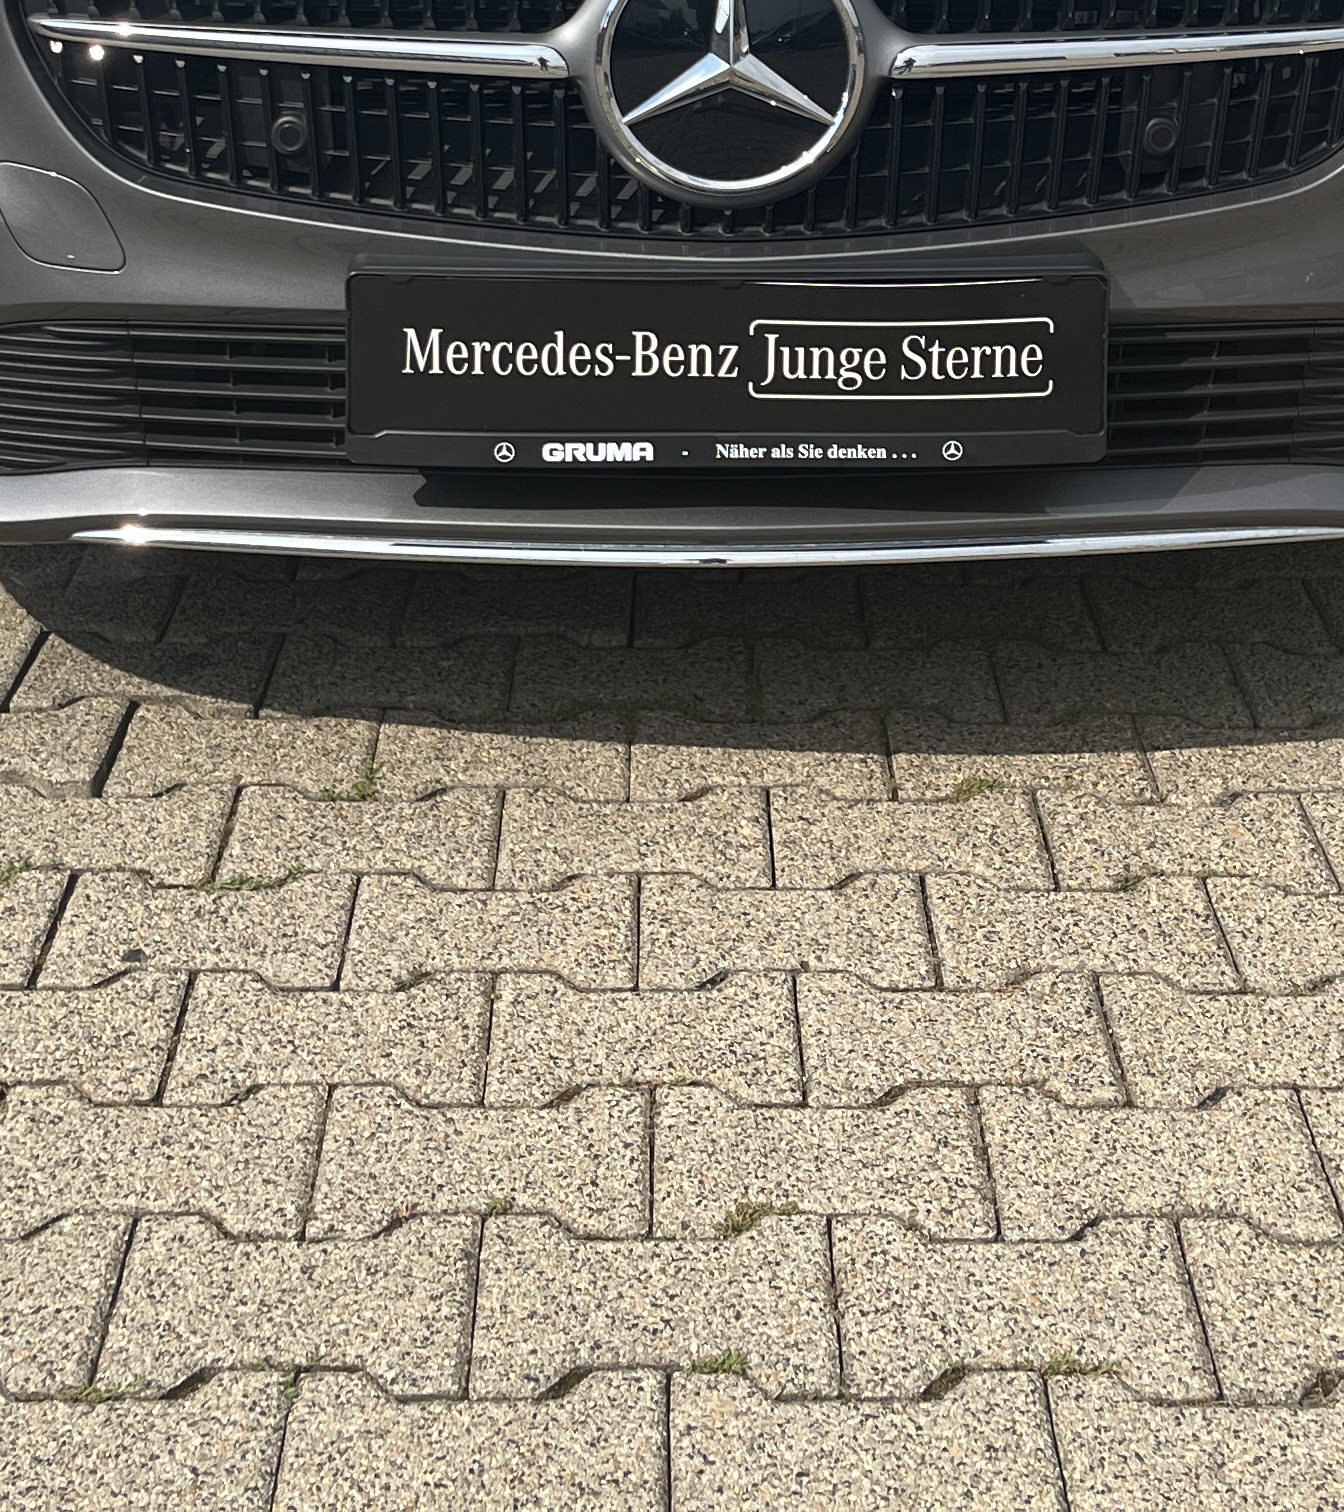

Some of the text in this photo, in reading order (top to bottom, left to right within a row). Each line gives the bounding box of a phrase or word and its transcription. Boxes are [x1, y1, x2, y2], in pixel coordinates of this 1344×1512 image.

[401, 327, 1043, 391] Mercedes-Benz Junge Sterne
[541, 441, 654, 463] GRUMA
[715, 443, 768, 459] Näher
[770, 443, 795, 459] als
[797, 443, 824, 459] Sie
[826, 443, 887, 460] denken
